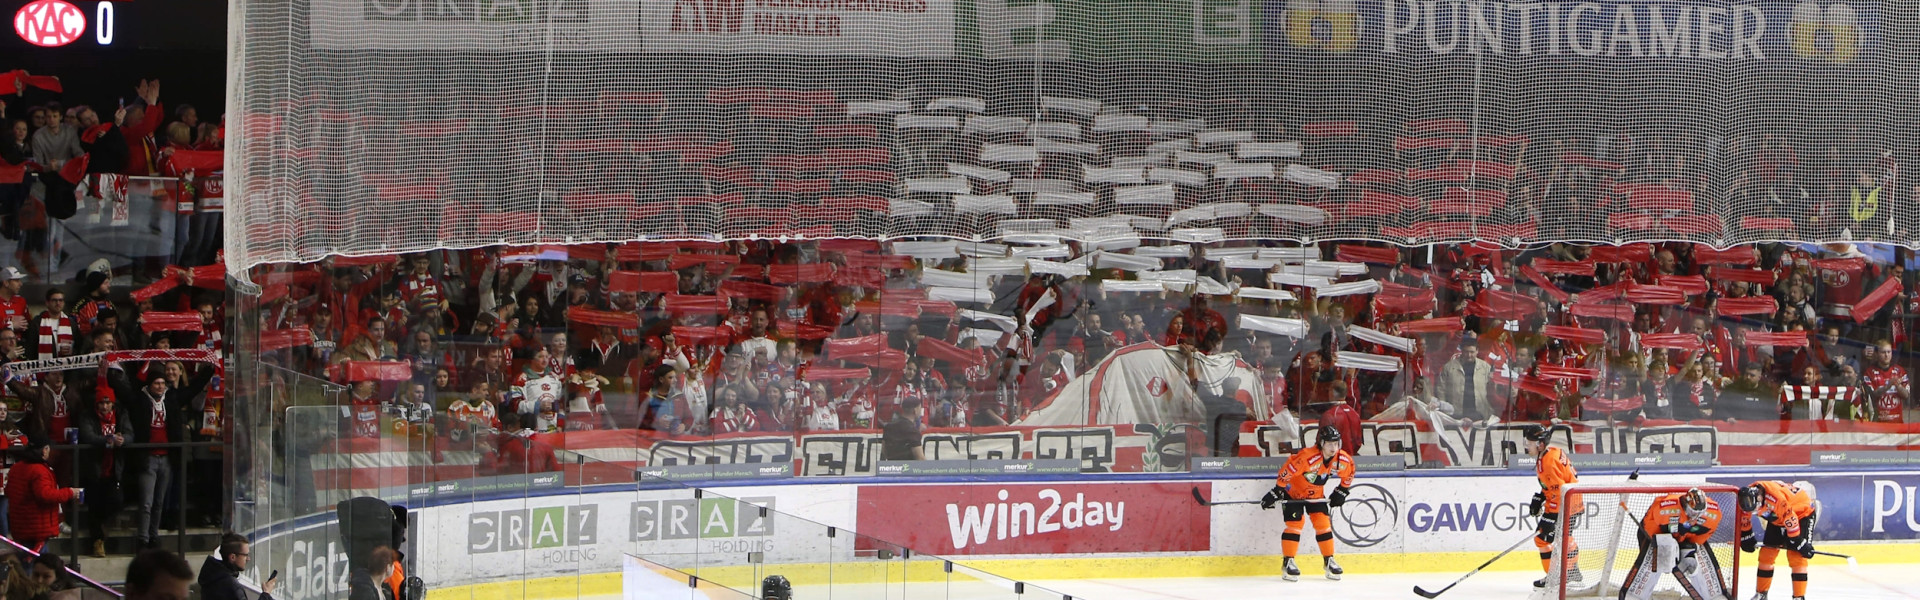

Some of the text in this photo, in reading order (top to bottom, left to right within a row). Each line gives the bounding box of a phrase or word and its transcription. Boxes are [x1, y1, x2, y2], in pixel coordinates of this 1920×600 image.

[22, 1, 79, 46] KAC
[96, 1, 114, 45] 0
[753, 13, 842, 37] MAKLER
[1381, 0, 1768, 61] PUNTIGAMER
[10, 358, 63, 373] SCHEISS
[534, 477, 553, 485] merkur
[472, 509, 592, 550] GRAZ
[637, 502, 768, 537] GRAZ
[945, 488, 1125, 549] win2day
[1407, 502, 1600, 533] GAWGRP
[712, 539, 774, 553] HOLDING
[286, 540, 350, 599] Glatz
